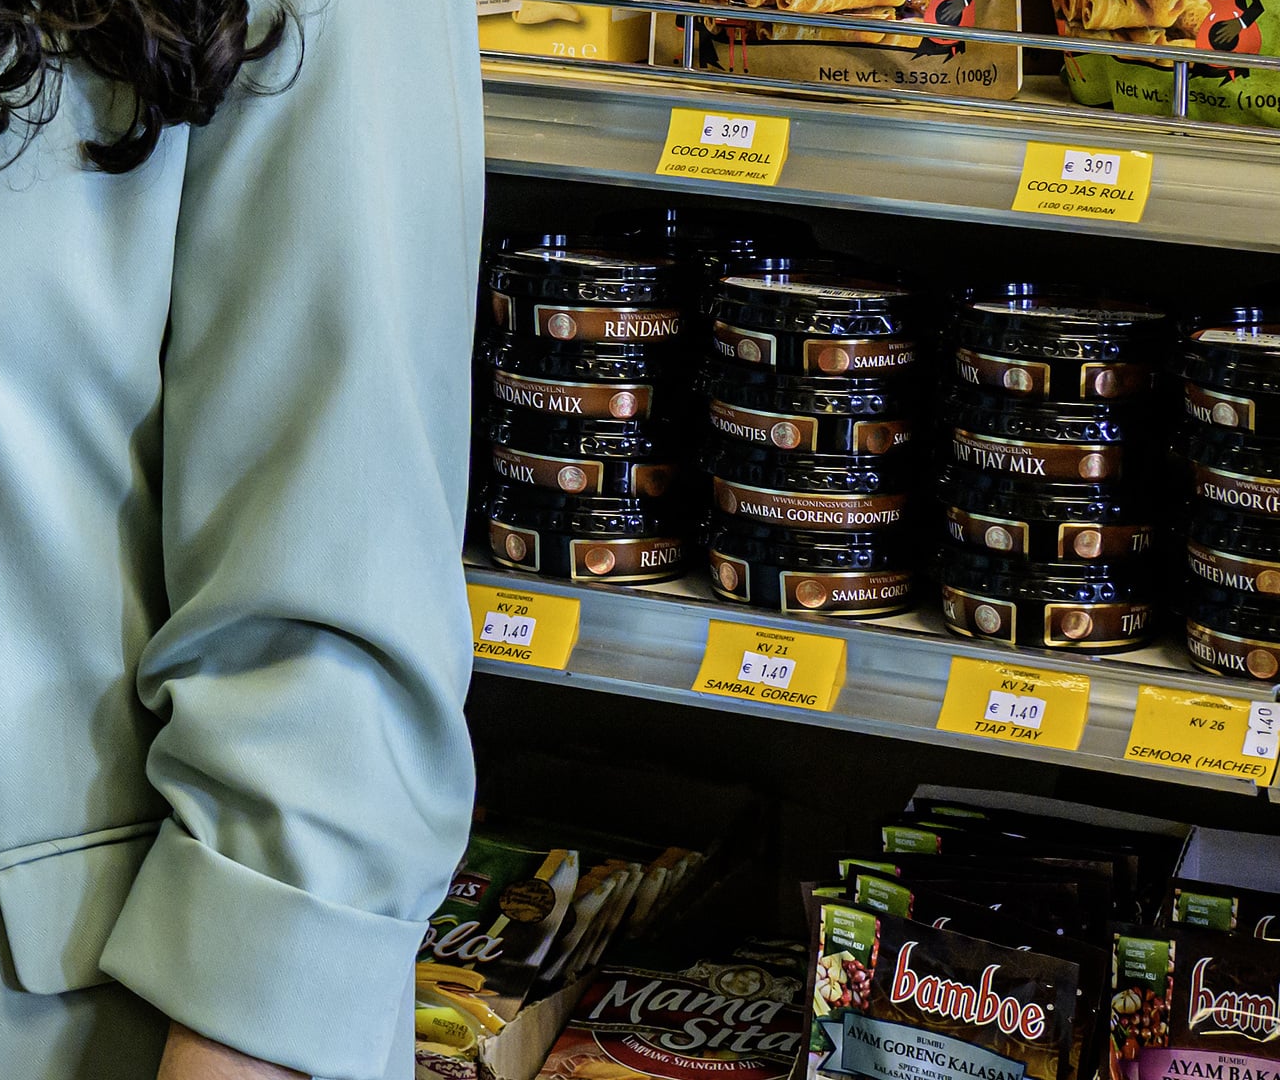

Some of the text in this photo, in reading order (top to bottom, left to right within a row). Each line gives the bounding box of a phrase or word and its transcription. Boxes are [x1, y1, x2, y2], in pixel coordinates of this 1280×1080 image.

[819, 66, 952, 85] Net 3.53oz.
[1116, 80, 1138, 98] Net
[704, 124, 749, 138] € 3.90
[671, 145, 771, 164] COCO JAS ROLL
[665, 163, 768, 180] (100 G) COCONUT MILK
[1065, 158, 1113, 174] € 3.90
[1027, 180, 1135, 201] COCO JAS ROLL
[1038, 201, 1116, 215] (100 G) PANDAN
[605, 318, 679, 338] RENDANG
[854, 354, 895, 368] SAMBAL
[961, 363, 980, 384] MIX
[548, 395, 582, 413] MIX
[1193, 404, 1212, 424] MIX
[719, 419, 767, 441] BOONTJES
[973, 447, 1005, 470] TJAY
[1010, 456, 1046, 476] MIX
[509, 463, 535, 484] MIX
[773, 496, 873, 508] WWW.KONINGSVOGEL.NL
[1204, 482, 1264, 510] SEMOOR
[741, 501, 900, 525] SAMBAL GORENG BOONTJES
[1226, 571, 1254, 592] MIX
[832, 588, 878, 601] SAMBAL
[497, 602, 528, 615] KV 20
[485, 623, 528, 638] € 1.40
[756, 631, 794, 641] KRUIDENMIX
[473, 642, 532, 659] RENDANG
[757, 643, 788, 655] KV 21
[1217, 650, 1245, 671] MIX
[743, 663, 787, 680] € 1.40
[704, 679, 817, 705] SAMBAL GORENG
[1001, 680, 1035, 693] KV 24
[990, 703, 1038, 720] € 1.40
[974, 721, 1043, 741] TJAP TJAY
[1189, 717, 1225, 731] KV 26
[1257, 708, 1272, 736] 1.40
[1129, 745, 1267, 777] SEMOOR (HACHEE)
[852, 941, 865, 950] ASLI
[891, 941, 1045, 1040] bamboe
[589, 980, 784, 1025] Mama
[660, 1017, 803, 1052] Sita
[916, 1035, 945, 1050] BUMBU
[622, 1034, 737, 1070] LUMPIANG SHANGHAI
[847, 1024, 1021, 1080] AYAM GORENG KALASAN
[1218, 1055, 1248, 1066] BUMBU
[873, 1064, 912, 1080] KALASAN
[898, 1062, 921, 1074] SPICE
[922, 1067, 937, 1078] MIX
[938, 1070, 952, 1080] FOR
[1168, 1059, 1222, 1080] AYAM
